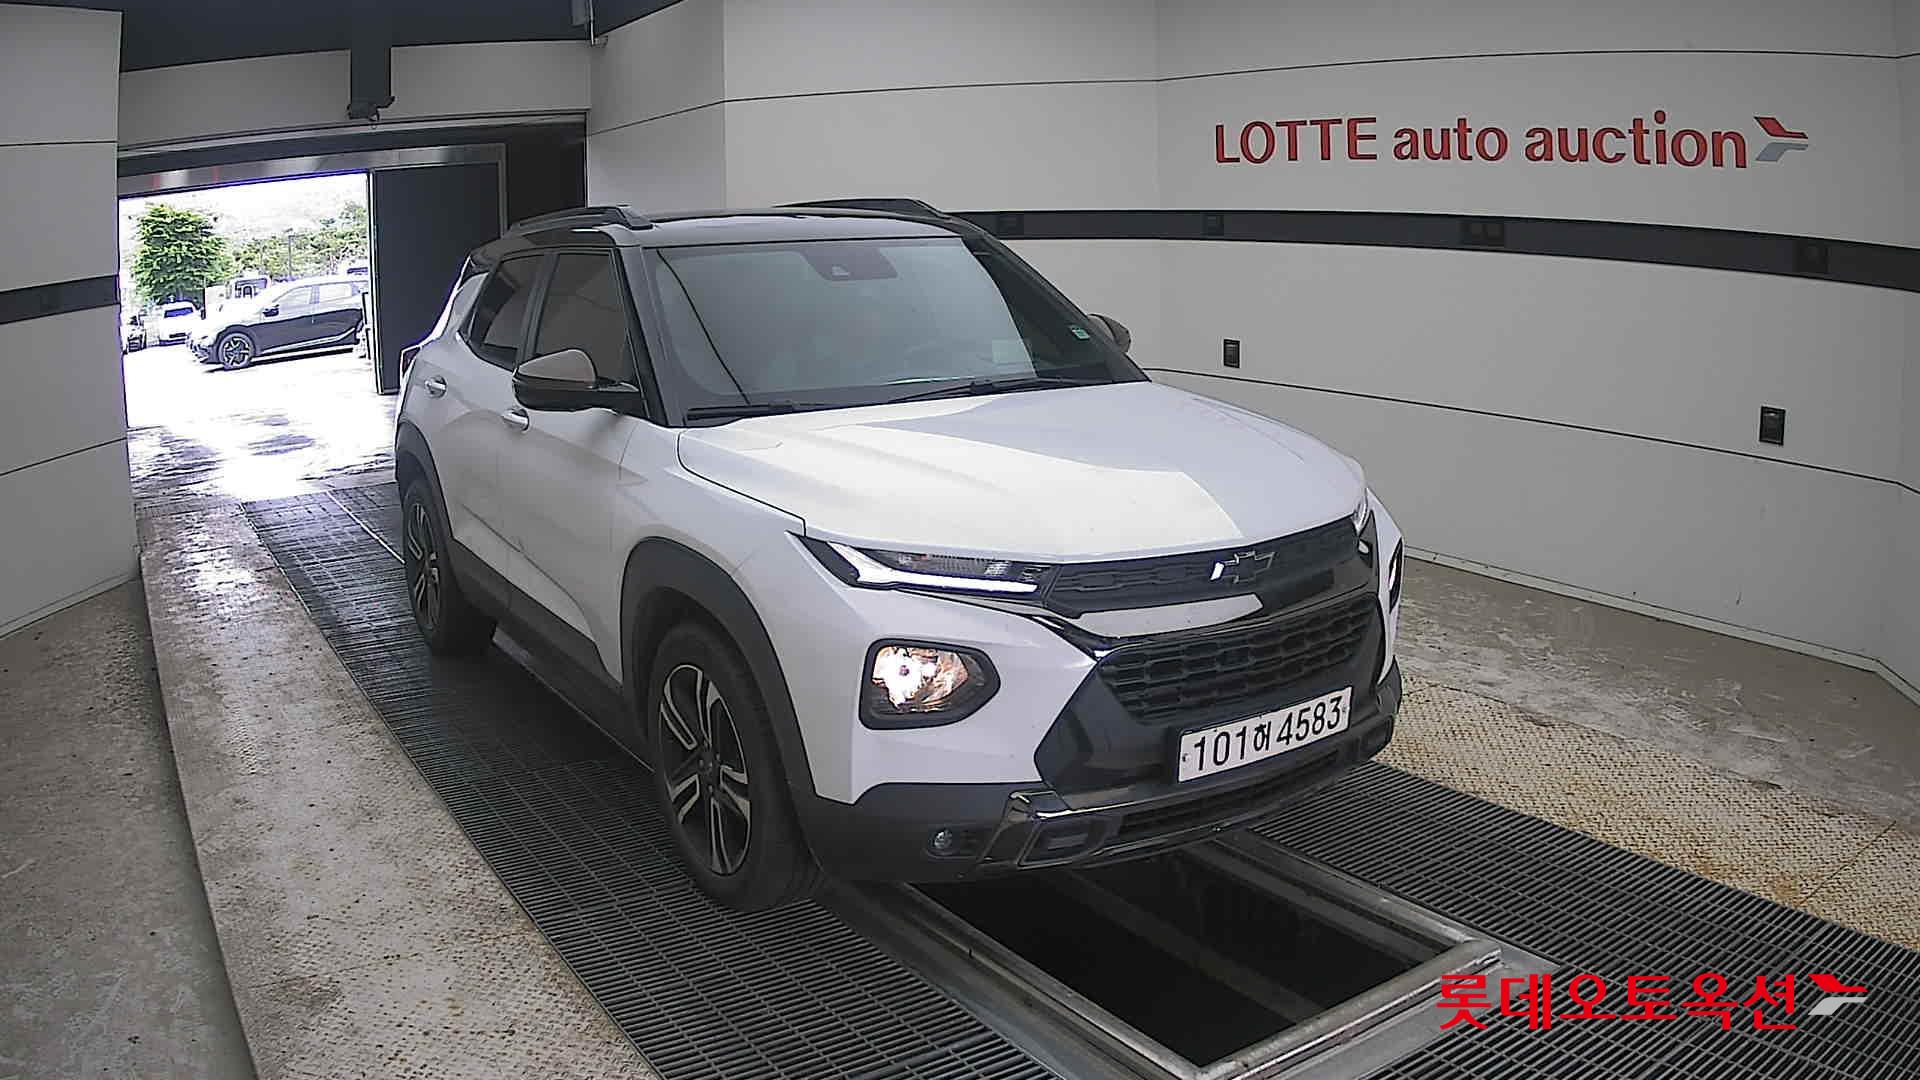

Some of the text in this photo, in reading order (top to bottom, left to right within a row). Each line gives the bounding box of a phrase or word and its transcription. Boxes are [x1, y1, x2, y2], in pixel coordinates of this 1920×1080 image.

[1215, 110, 1747, 168] LOTTE auto auction
